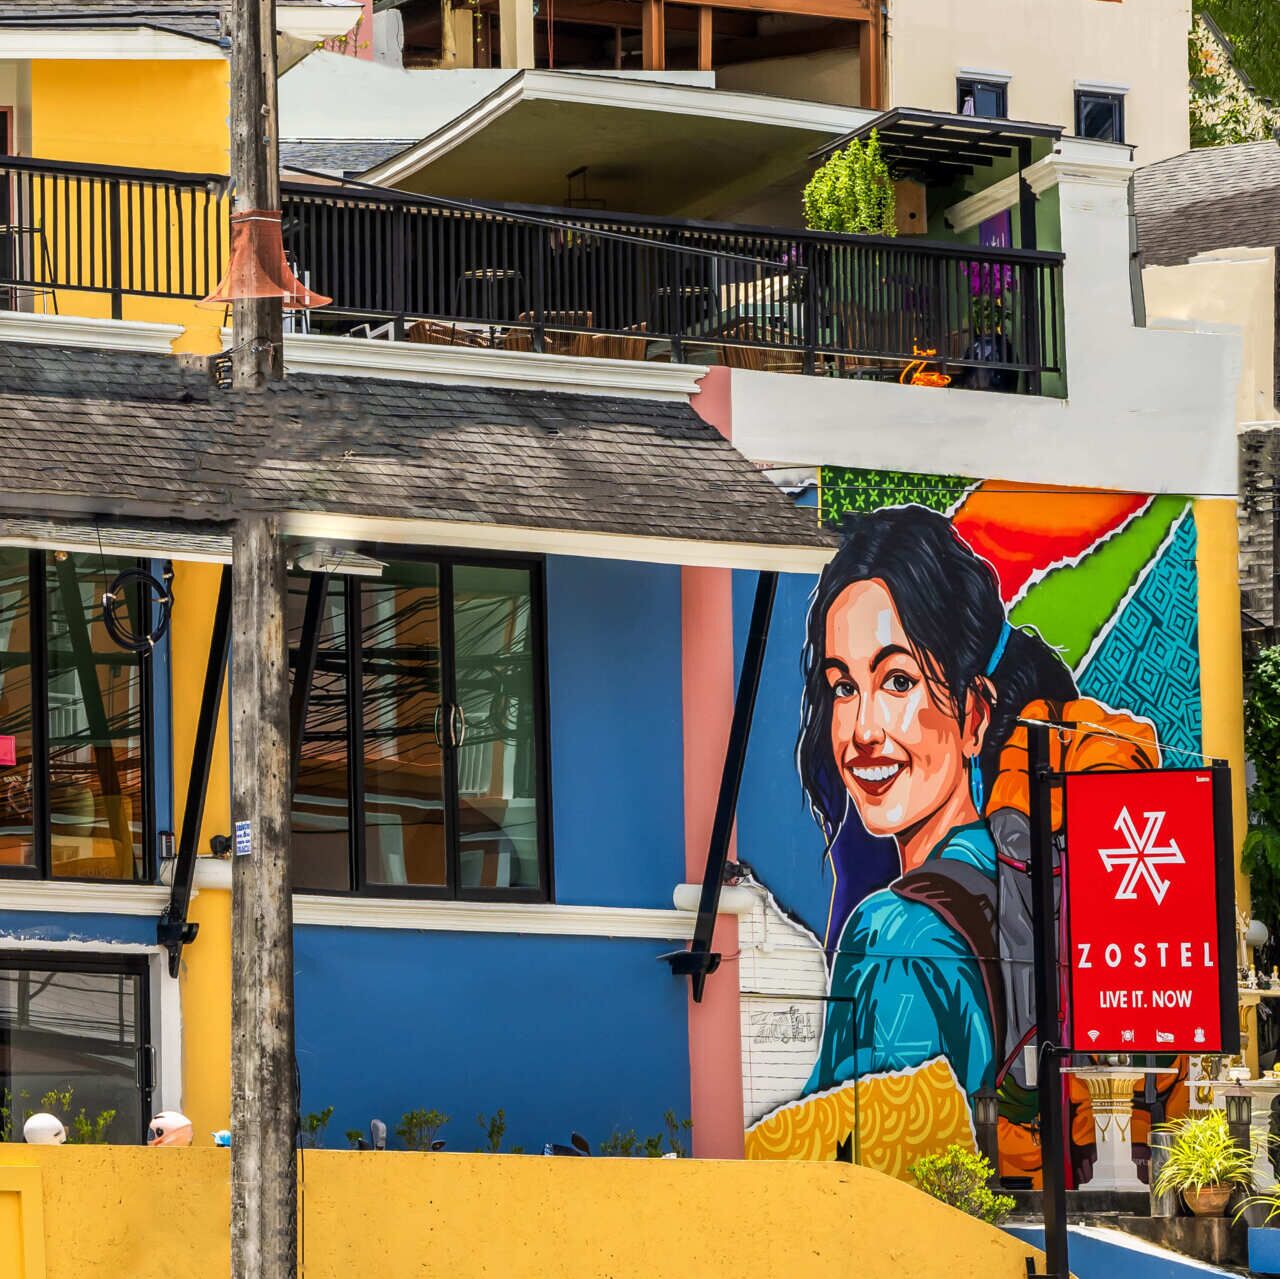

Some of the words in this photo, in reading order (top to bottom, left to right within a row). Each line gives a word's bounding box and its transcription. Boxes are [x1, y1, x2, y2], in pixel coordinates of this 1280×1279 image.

[1077, 942, 1215, 969] ZOSTEL
[1099, 989, 1128, 1009] LIVE
[1131, 990, 1149, 1008] IT.
[1152, 989, 1193, 1008] NOW
